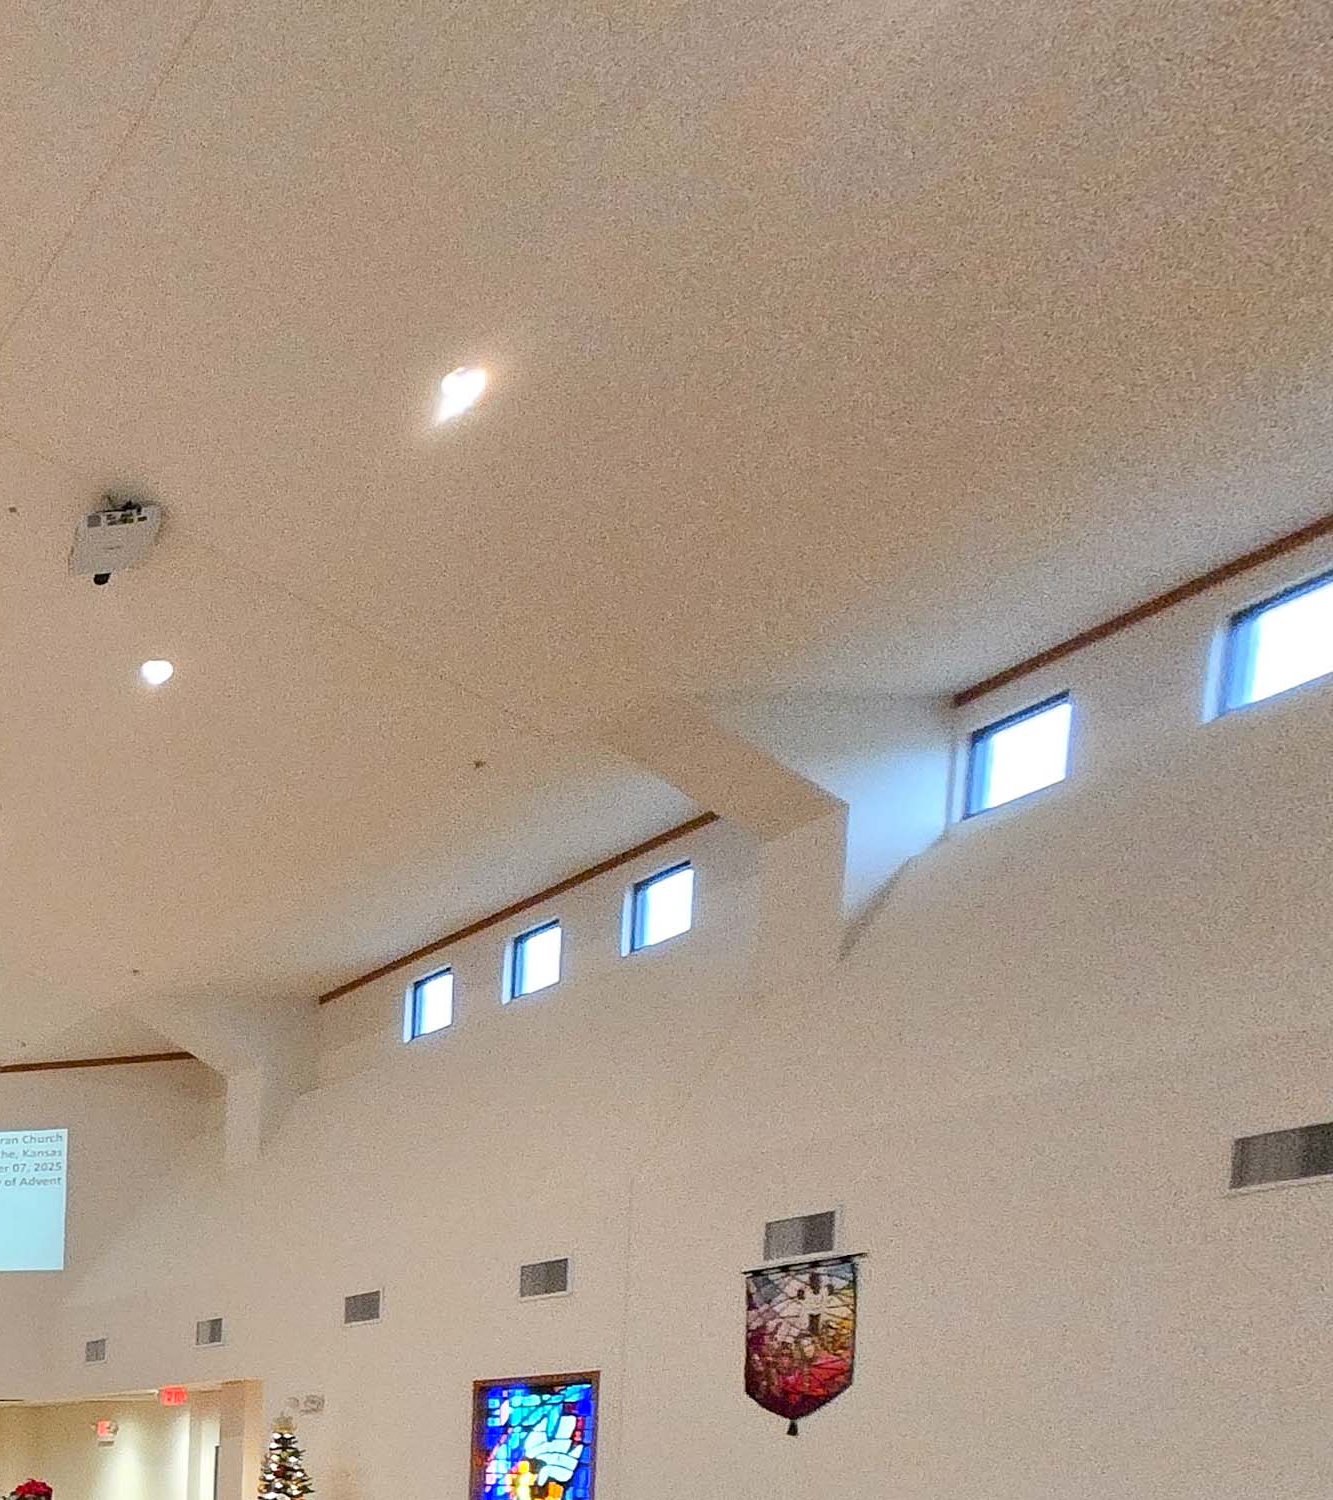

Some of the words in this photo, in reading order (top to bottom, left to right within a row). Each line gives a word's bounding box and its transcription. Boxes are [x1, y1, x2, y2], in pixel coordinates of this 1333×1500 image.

[22, 1132, 63, 1144] Church
[22, 1148, 63, 1158] Kansas
[34, 1161, 62, 1172] 2025
[4, 1177, 17, 1187] of
[19, 1176, 62, 1187] Advent
